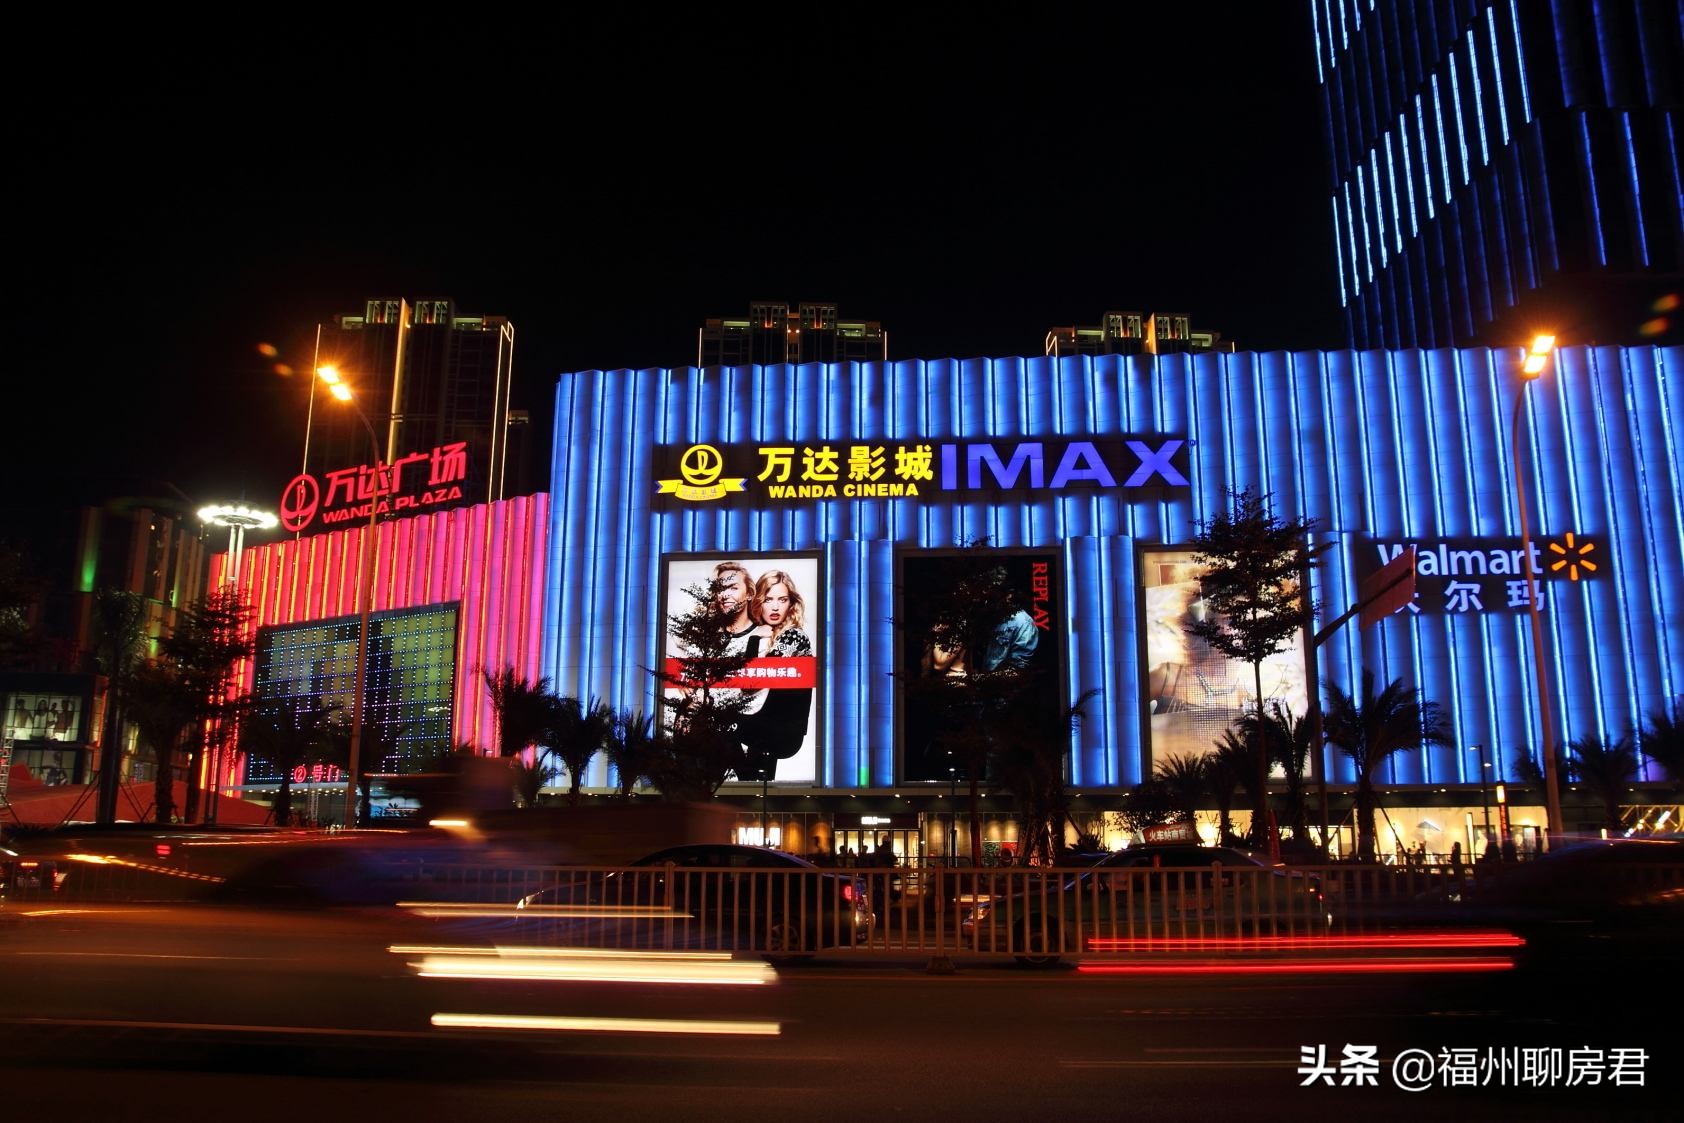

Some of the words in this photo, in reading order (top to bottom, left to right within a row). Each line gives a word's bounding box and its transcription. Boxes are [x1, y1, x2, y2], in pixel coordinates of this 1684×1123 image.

[324, 441, 467, 507] 万达广场
[757, 445, 934, 483] 万达影城
[941, 440, 1190, 490] IMAX
[322, 501, 389, 524] WANDA
[394, 486, 463, 510] PLAZA
[768, 485, 837, 498] WANDA
[843, 483, 919, 497] CINEMA
[1033, 562, 1050, 631] REPLAY
